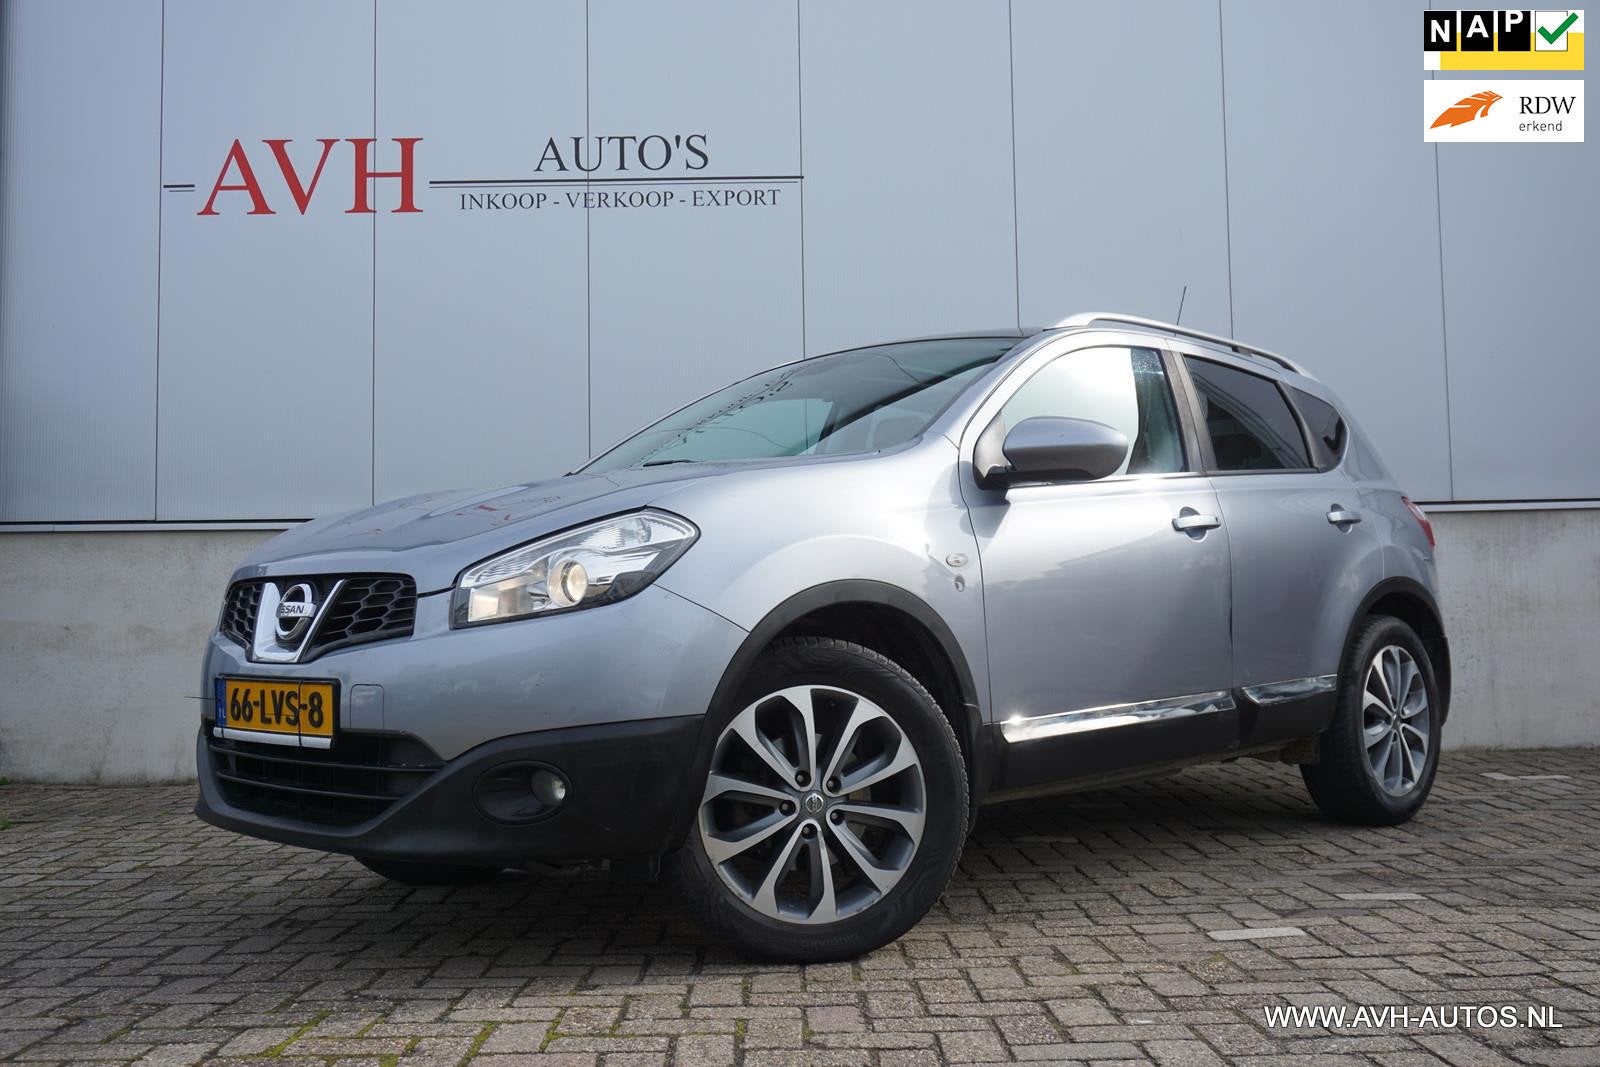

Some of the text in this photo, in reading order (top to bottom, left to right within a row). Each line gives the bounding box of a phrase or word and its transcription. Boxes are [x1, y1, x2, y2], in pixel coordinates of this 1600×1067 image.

[533, 134, 710, 173] AUTO'S
[196, 137, 424, 216] AVH
[459, 193, 548, 211] INKOOP
[565, 191, 675, 210] VERKOOP
[692, 189, 782, 208] EXPORT
[230, 687, 324, 729] 66-LVS-8
